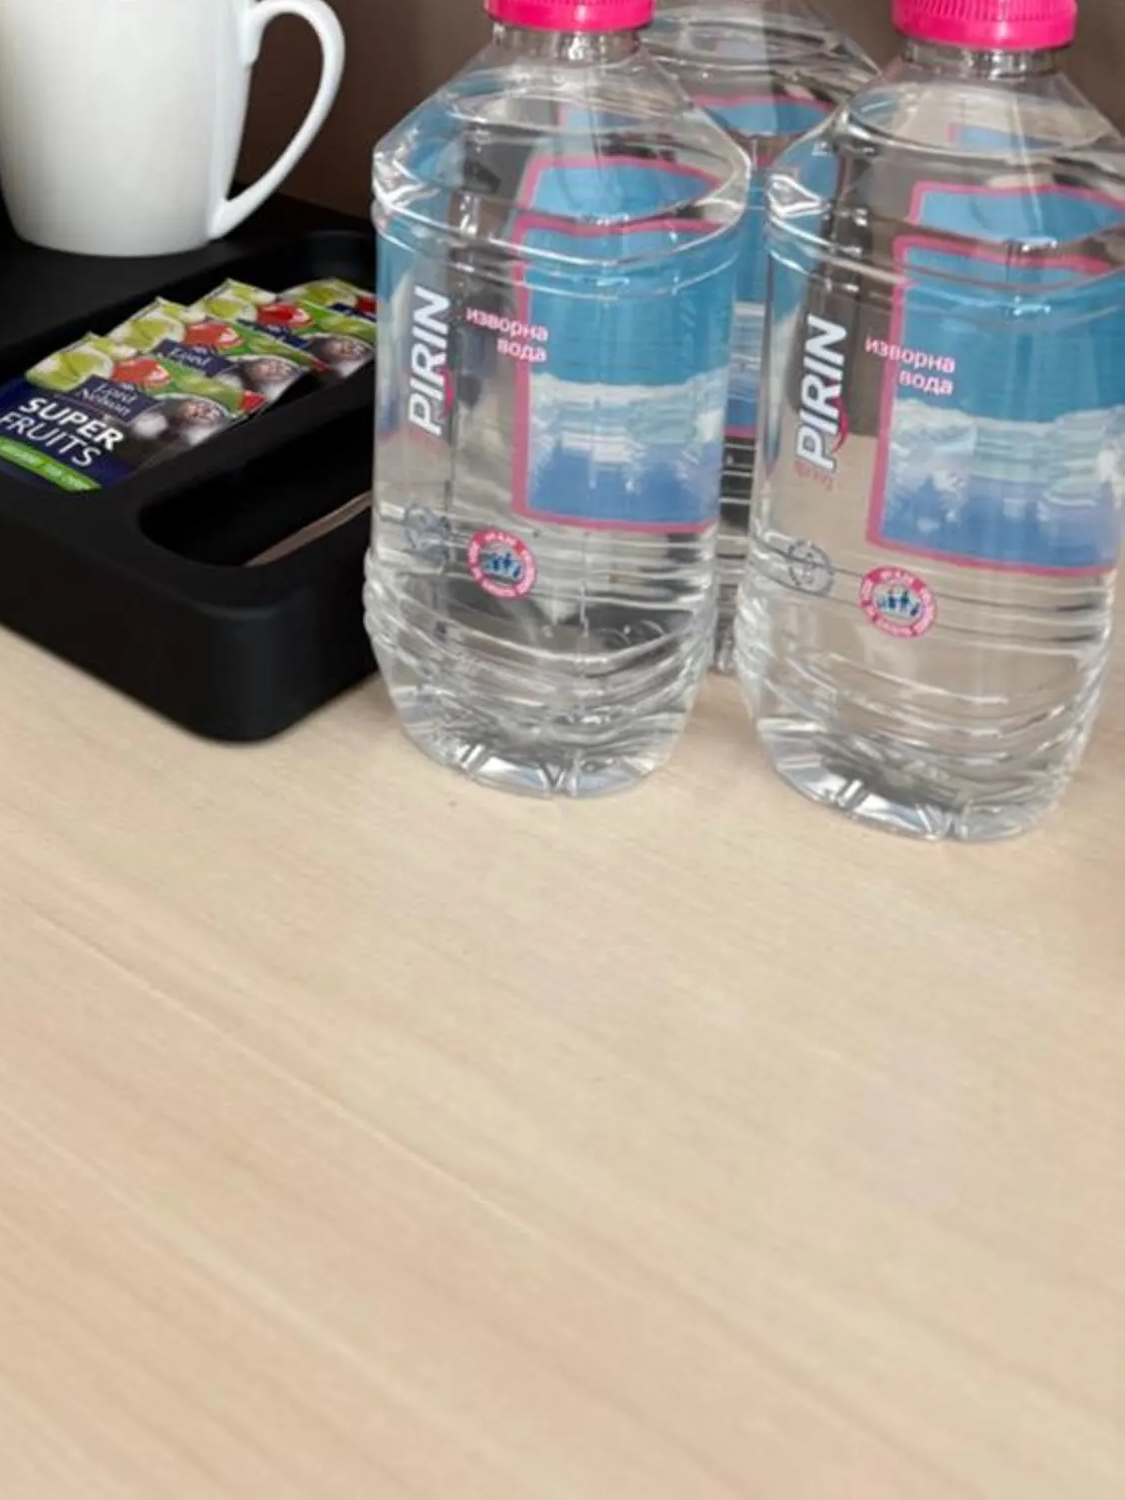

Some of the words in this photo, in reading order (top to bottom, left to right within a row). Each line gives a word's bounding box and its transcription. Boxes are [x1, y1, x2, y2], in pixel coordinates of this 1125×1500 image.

[466, 308, 548, 341] изворна
[408, 287, 451, 435] PIRIN
[497, 338, 547, 362] вода
[865, 338, 956, 372] изворна
[796, 314, 847, 470] PIRIN
[900, 371, 954, 396] вода
[19, 397, 124, 452] SUPER
